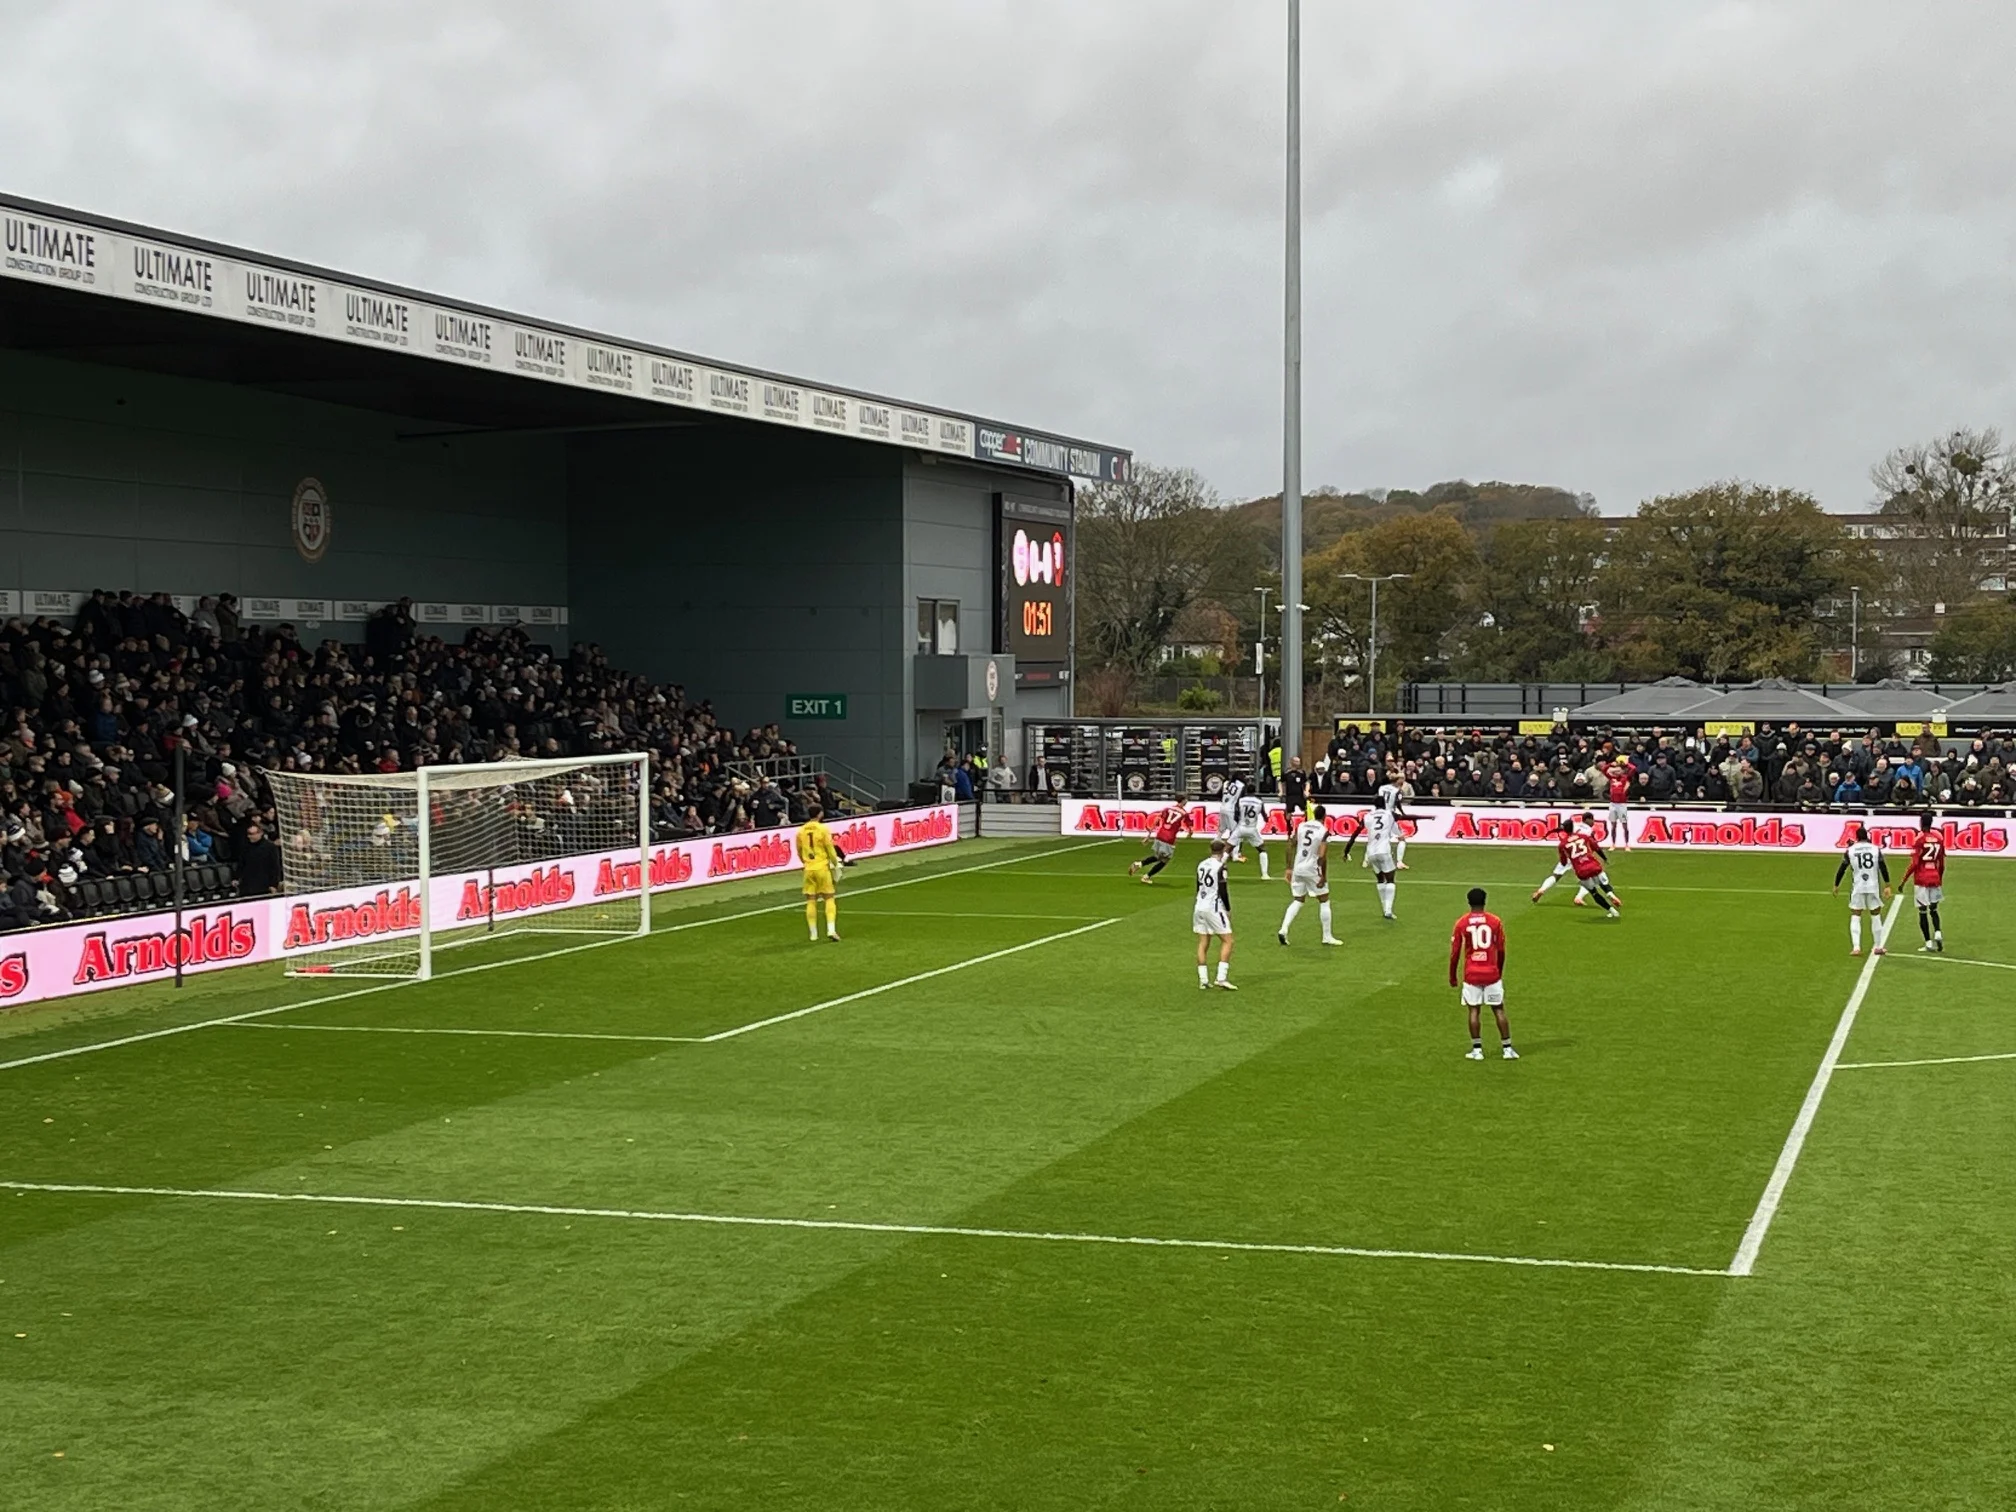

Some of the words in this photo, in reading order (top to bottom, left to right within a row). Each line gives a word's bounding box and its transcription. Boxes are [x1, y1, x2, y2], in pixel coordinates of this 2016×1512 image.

[6, 218, 94, 268] ULTIMATE
[6, 256, 56, 277] CONSTRUCTION
[59, 267, 81, 280] GROUP
[83, 273, 94, 284] LTD
[134, 246, 212, 292] ULTIMATE
[247, 272, 316, 314] ULTIMATE
[346, 293, 408, 332] ULTIMATE
[436, 314, 490, 350] ULTIMATE
[515, 332, 564, 365] ULTIMATE
[587, 347, 632, 378] ULTIMATE
[652, 360, 692, 390] ULTIMATE
[710, 374, 748, 402] ULTIMATE
[1024, 438, 1068, 472] COMMUNITY
[1070, 448, 1100, 477] STADIUM
[792, 700, 830, 714] EXIT
[834, 700, 842, 715] 1
[1166, 810, 1183, 824] 17
[1243, 805, 1256, 818] 16
[1374, 816, 1384, 830] 3
[807, 832, 814, 848] 1
[890, 810, 952, 848] Arnolds
[1304, 830, 1313, 846] 5
[1446, 812, 1608, 842] Arnols
[1638, 816, 1805, 847] Arnolds
[708, 833, 790, 878] Arnolds
[1566, 838, 1588, 859] 23
[1855, 852, 1874, 869] 18
[1198, 868, 1214, 888] 26
[284, 886, 421, 950] Arnolds
[74, 912, 256, 985] Arnolds
[1466, 924, 1492, 950] 10
